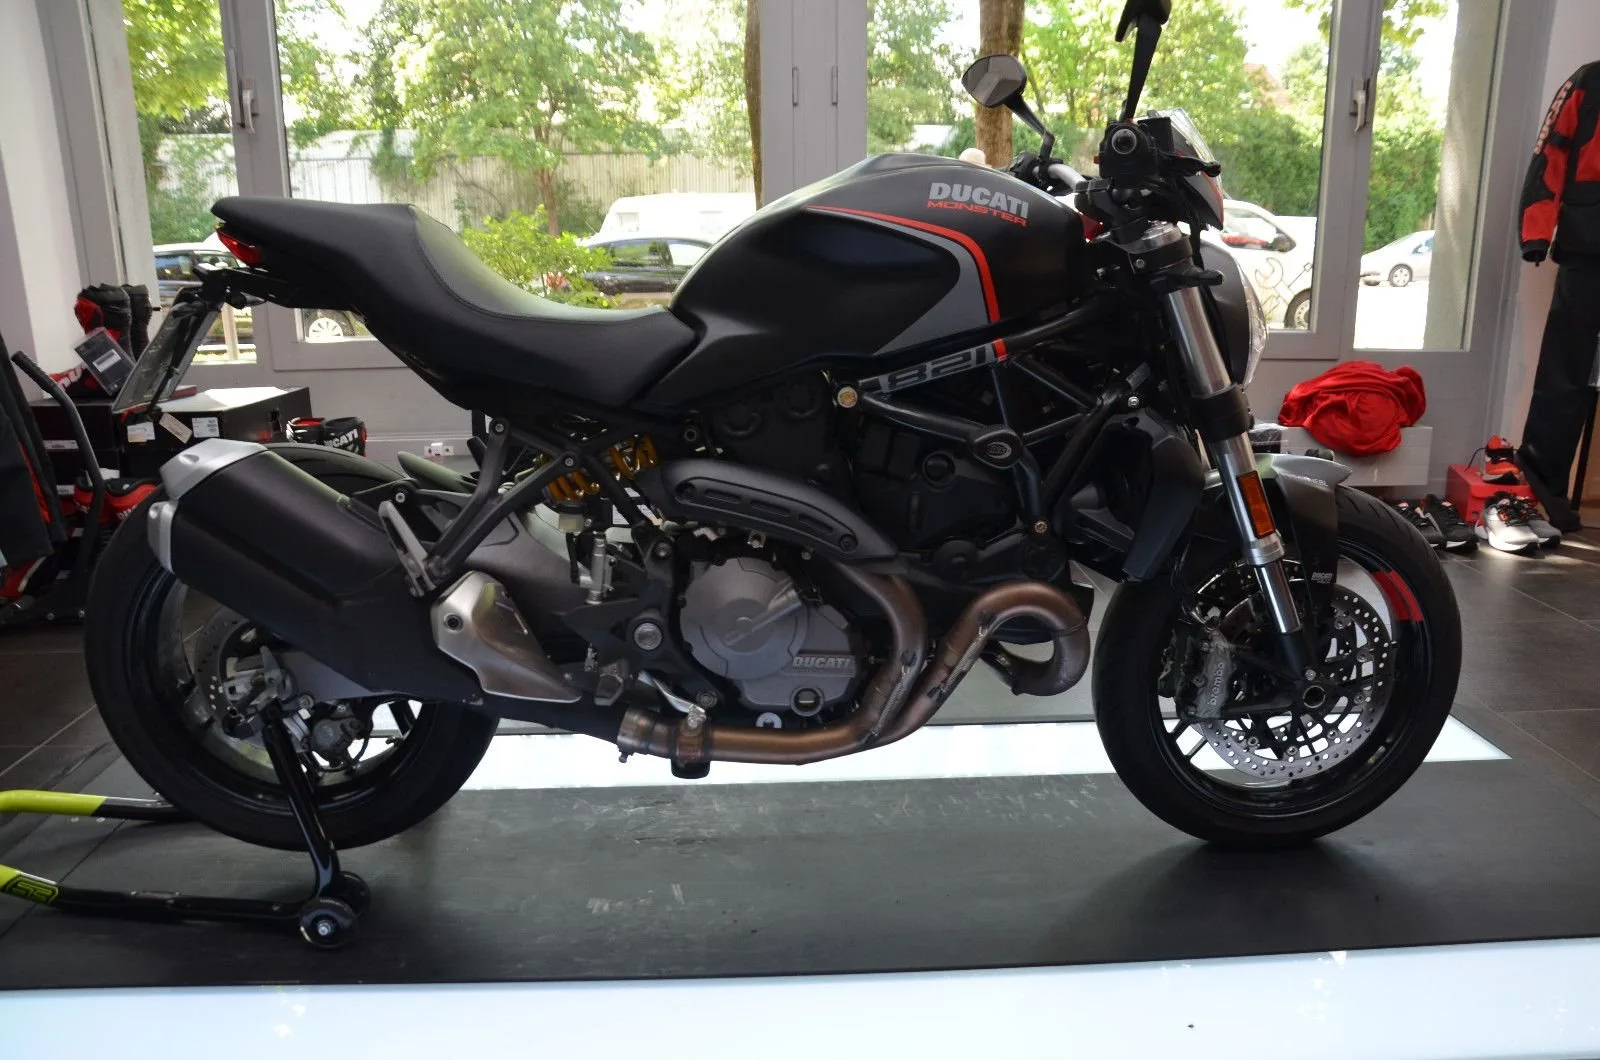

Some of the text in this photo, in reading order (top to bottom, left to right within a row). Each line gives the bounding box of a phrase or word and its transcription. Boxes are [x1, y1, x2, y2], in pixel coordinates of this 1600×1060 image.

[927, 200, 1029, 227] MONSTER
[928, 182, 1029, 219] DUCATI
[887, 346, 986, 389] 821
[792, 656, 851, 669] DUCATI
[1207, 662, 1225, 706] brembo
